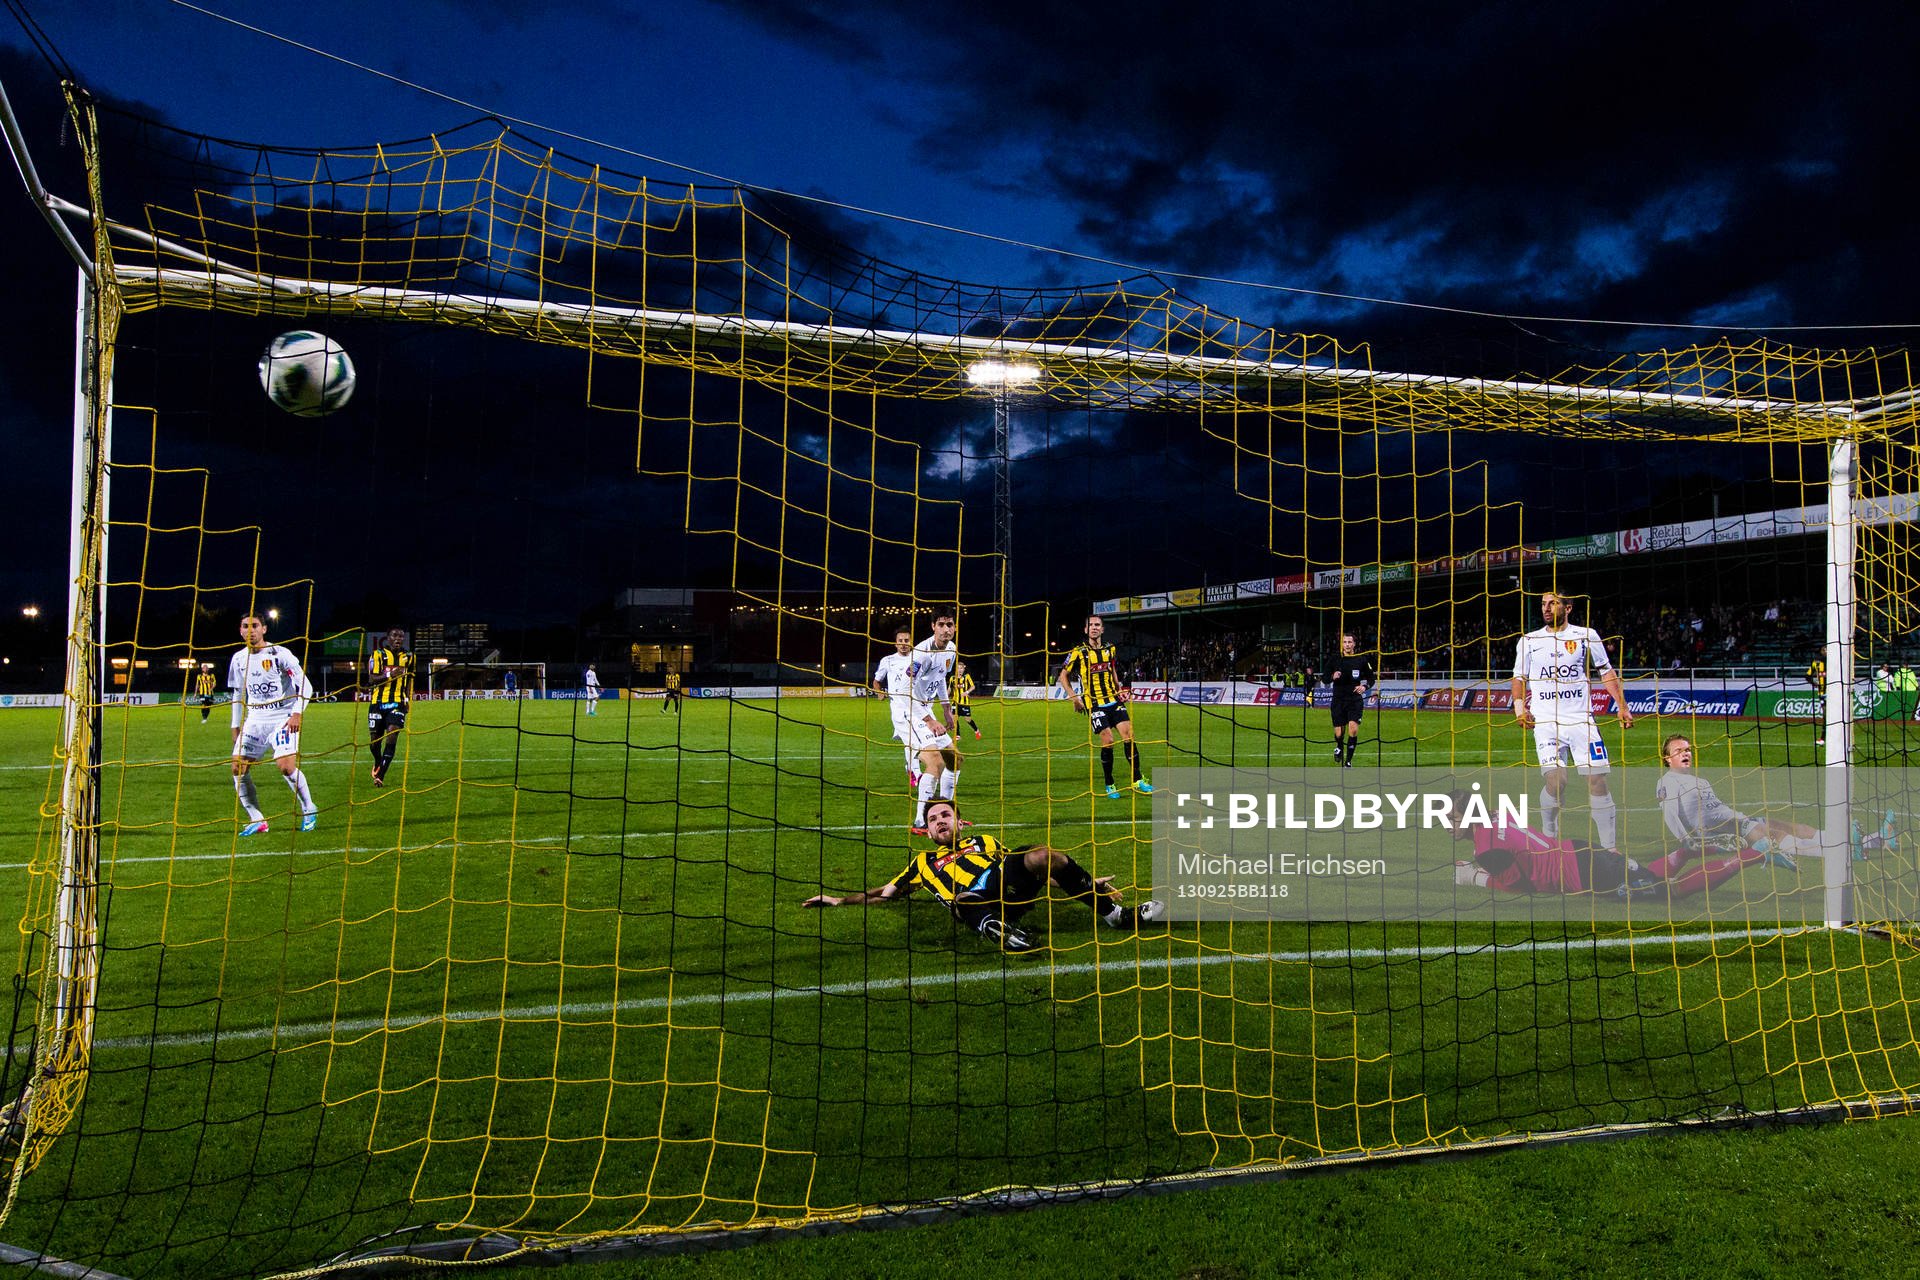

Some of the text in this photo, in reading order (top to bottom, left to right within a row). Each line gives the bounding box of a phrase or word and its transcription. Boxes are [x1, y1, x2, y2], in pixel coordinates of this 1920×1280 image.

[1757, 526, 1787, 536] BOHUS
[1319, 569, 1355, 587] Tingsad
[1206, 584, 1234, 596] REKLAM
[1540, 664, 1579, 679] AROS
[14, 695, 49, 705] ELIT
[1476, 694, 1507, 703] BRA
